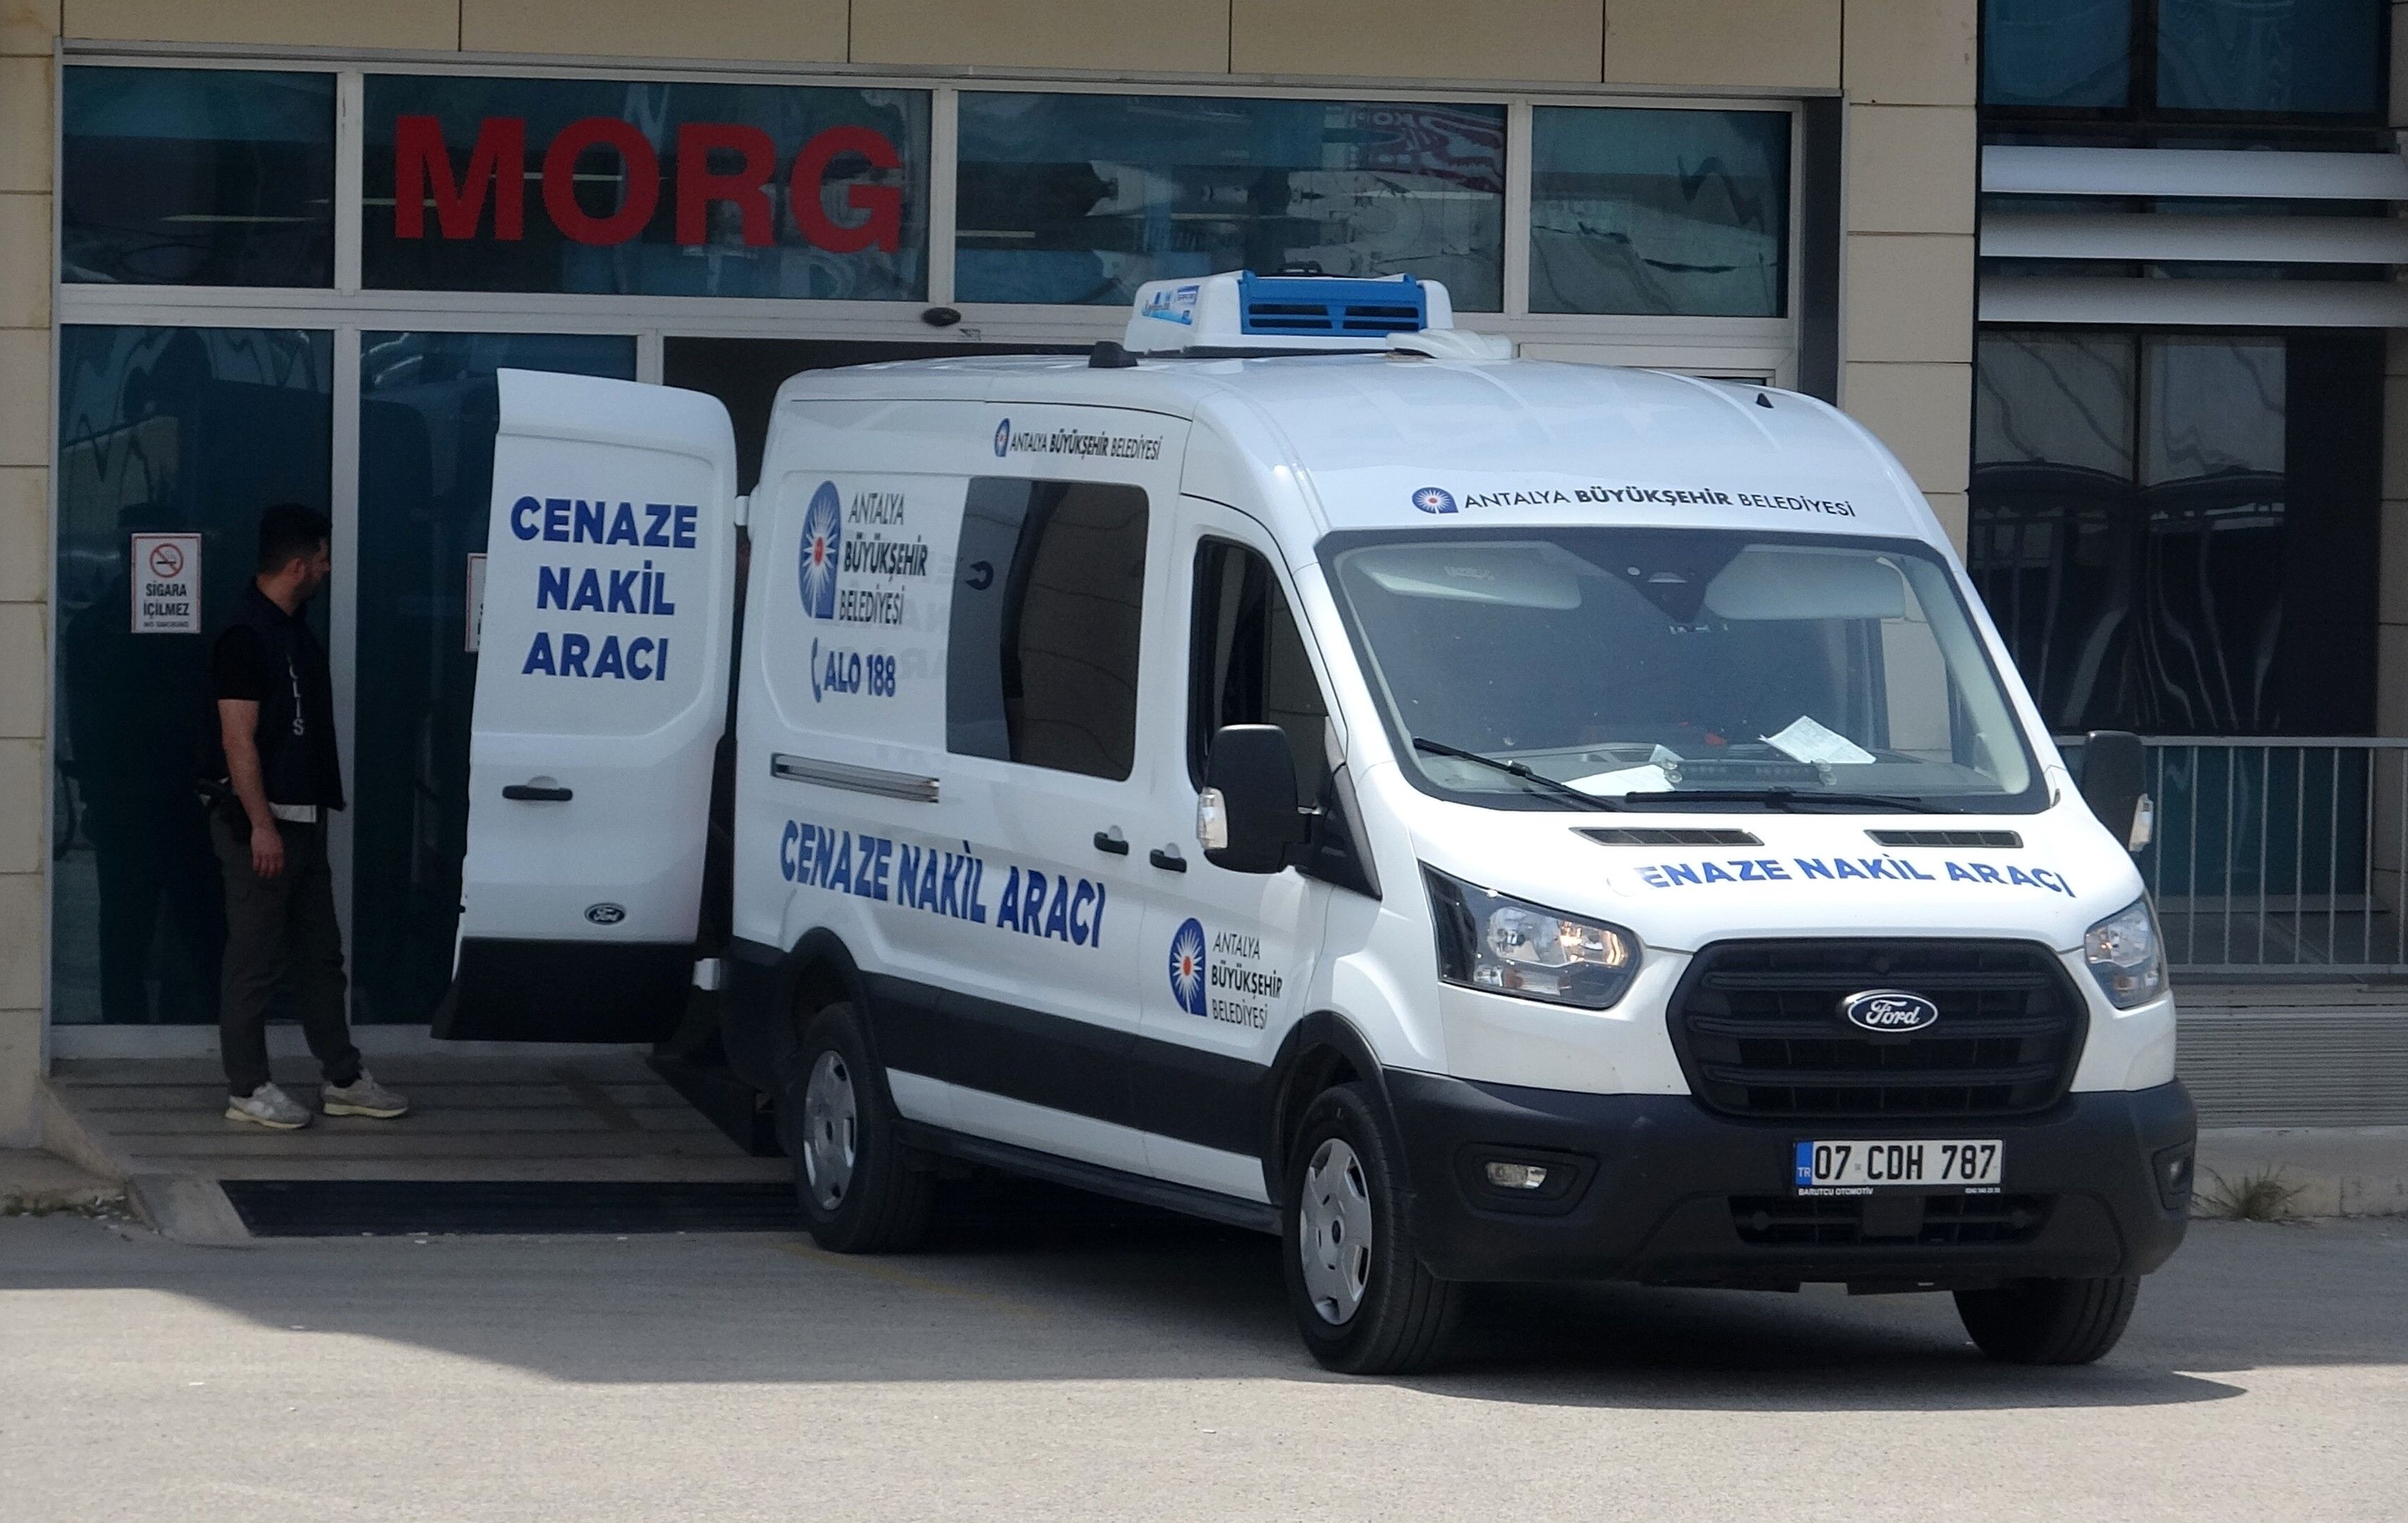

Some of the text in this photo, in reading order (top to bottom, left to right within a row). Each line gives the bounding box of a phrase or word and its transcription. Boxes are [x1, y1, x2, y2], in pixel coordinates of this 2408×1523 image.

[395, 115, 902, 254] MORG
[1010, 427, 1163, 460] ANTALYA BÜYÜKŞEHİR BELEDİYESİ
[848, 493, 904, 525] ANTALYA
[1465, 486, 1855, 517] ANTALYA BÜYÜKŞEHİR BELEDİYESİ
[510, 496, 698, 549] CENAZE
[844, 532, 928, 582] BÜYÜKŞEHİR
[145, 580, 187, 597] SİGARA
[536, 559, 675, 616] NAKİL
[839, 583, 905, 625] BELEDİYESİ
[143, 600, 190, 619] İÇİLMEZ
[522, 632, 668, 681] ARACI
[824, 650, 896, 697] ALO 188
[780, 819, 1106, 948] CENAZE NAKİL ARACI
[1633, 853, 2077, 898] ENAZE NAKİL ARACI
[1212, 931, 1260, 960] ANTALYA
[1211, 960, 1283, 1000] BÜYÜKŞEHİR
[1212, 998, 1268, 1030] BELEDİYESİ
[1866, 1000, 1921, 1024] Ford
[1797, 1167, 1812, 1178] TR
[1814, 1144, 1996, 1180] 07 CDH 787
